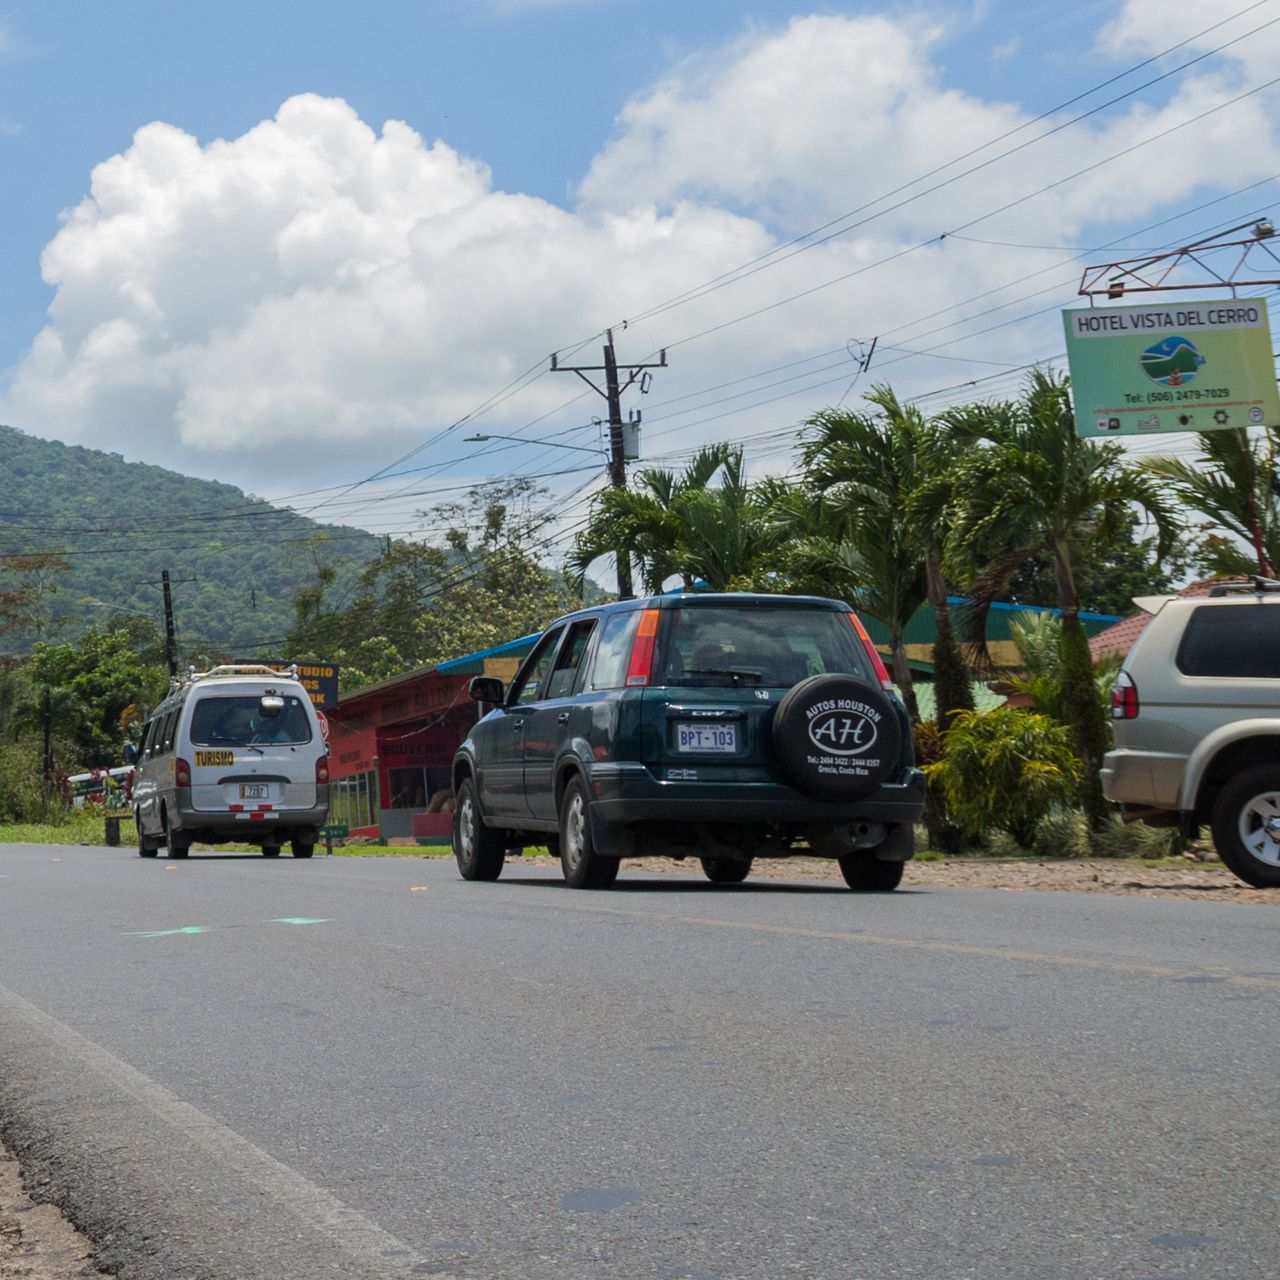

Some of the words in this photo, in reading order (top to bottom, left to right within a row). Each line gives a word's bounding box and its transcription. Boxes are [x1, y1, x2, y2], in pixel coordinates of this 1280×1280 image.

[1078, 316, 1128, 332] HOTEL
[1130, 312, 1174, 329] VISTA
[1176, 310, 1205, 326] DEL
[1207, 307, 1258, 325] CERRO
[1124, 394, 1143, 404] Tel:
[297, 666, 333, 677] TUDIO
[805, 700, 836, 720] AUTOS
[838, 699, 882, 723] HOUSTON
[814, 718, 866, 744] AH
[196, 751, 234, 767] TURISMO
